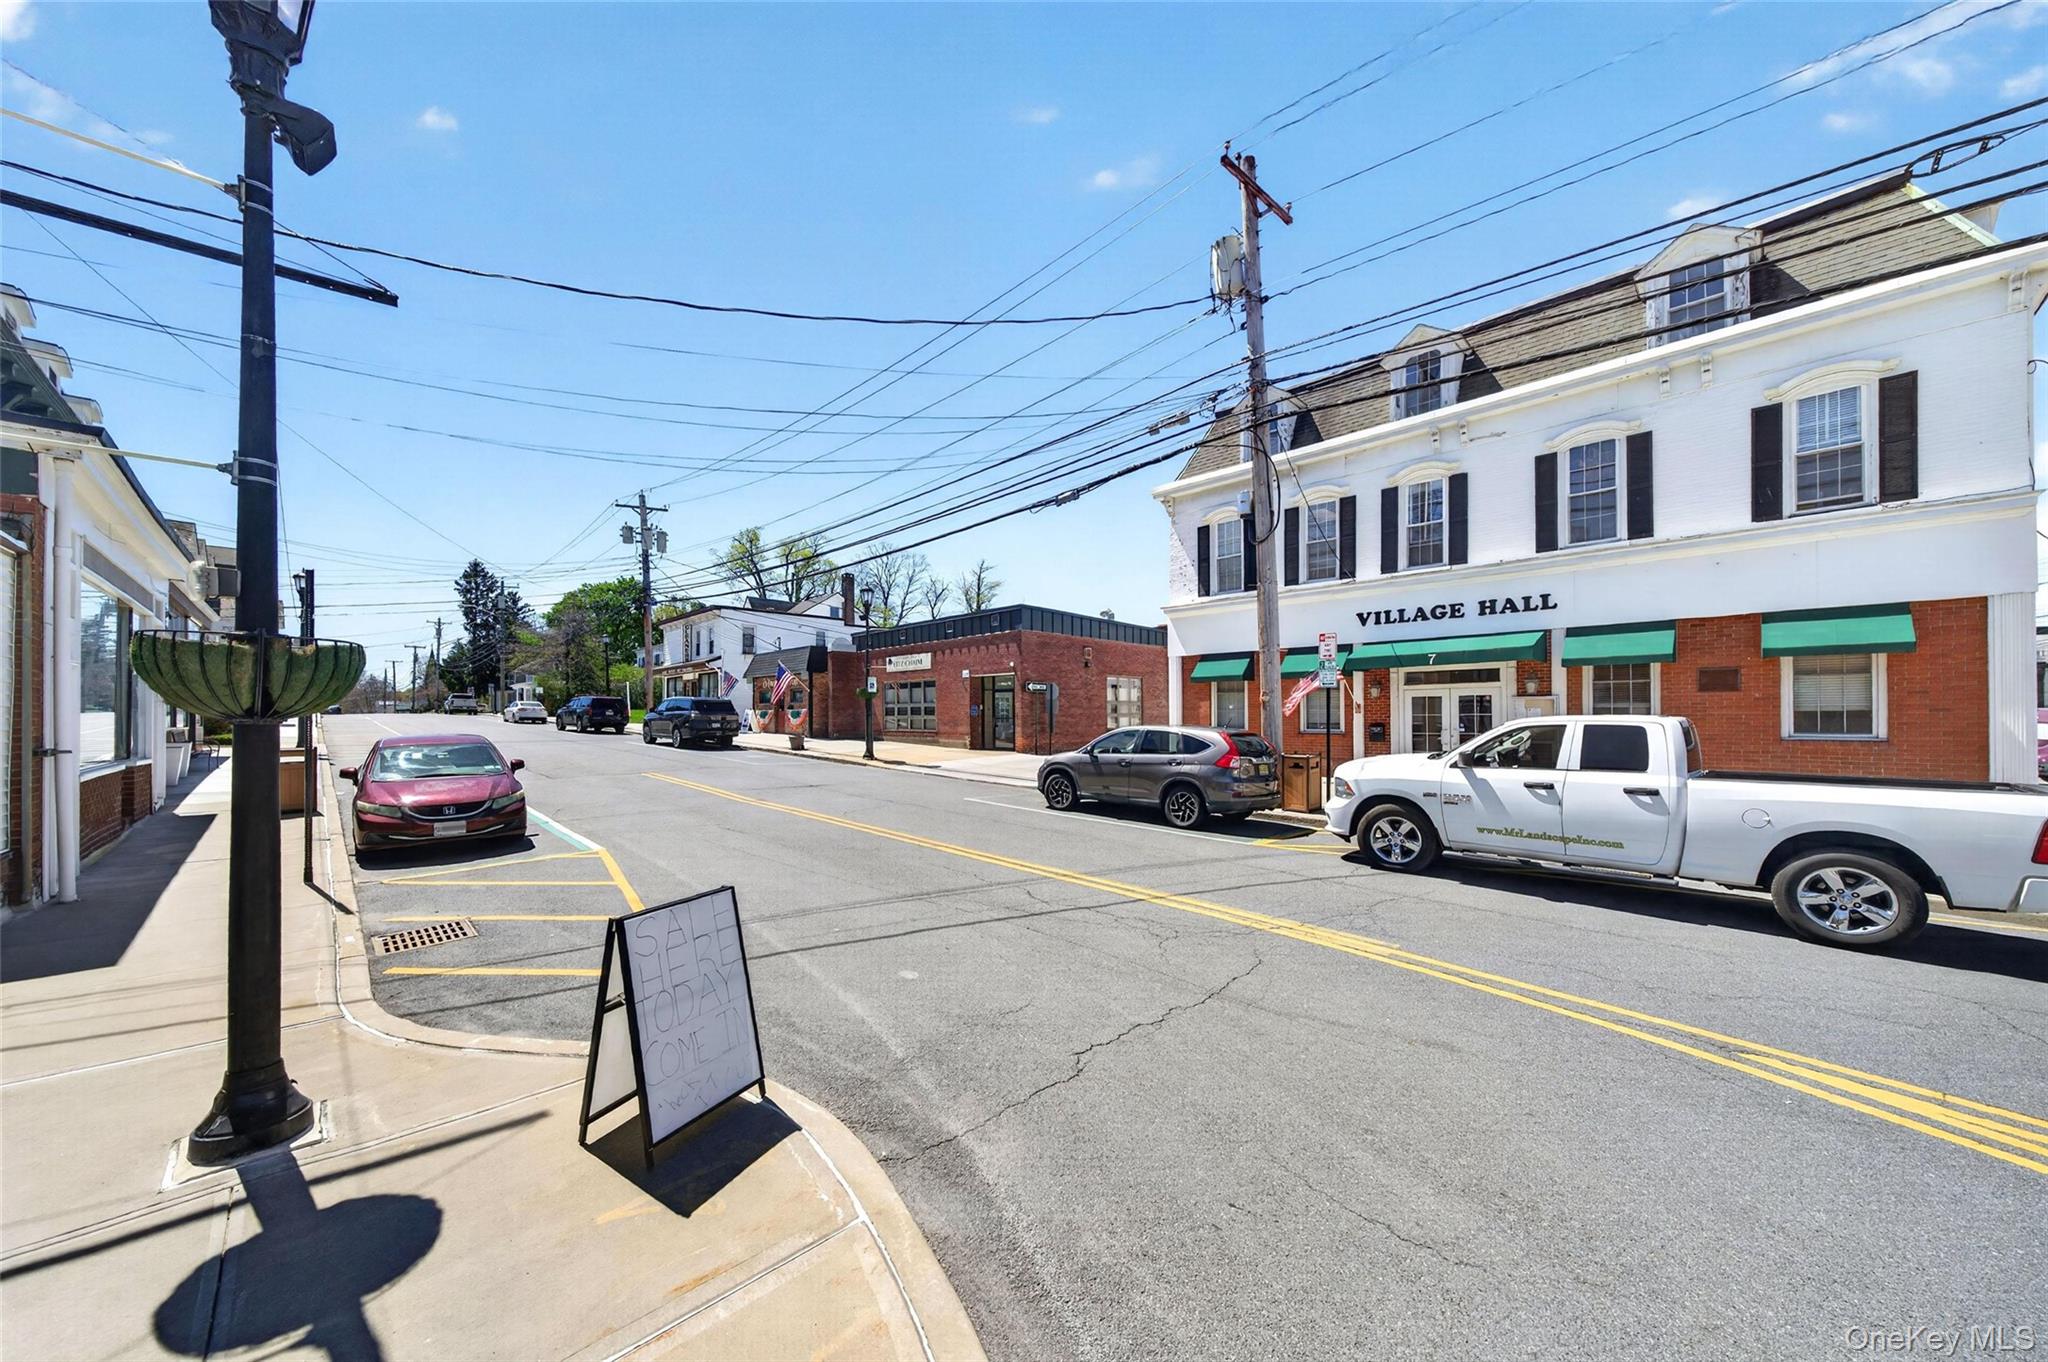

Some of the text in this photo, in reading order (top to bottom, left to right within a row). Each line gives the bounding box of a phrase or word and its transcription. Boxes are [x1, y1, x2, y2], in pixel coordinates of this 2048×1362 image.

[1356, 593, 1558, 627] VILLAGE HALL
[1427, 653, 1436, 665] 7
[634, 895, 737, 957] SALE
[639, 924, 741, 997] HERE
[634, 962, 735, 1041] TODAY
[644, 1026, 706, 1086] COME
